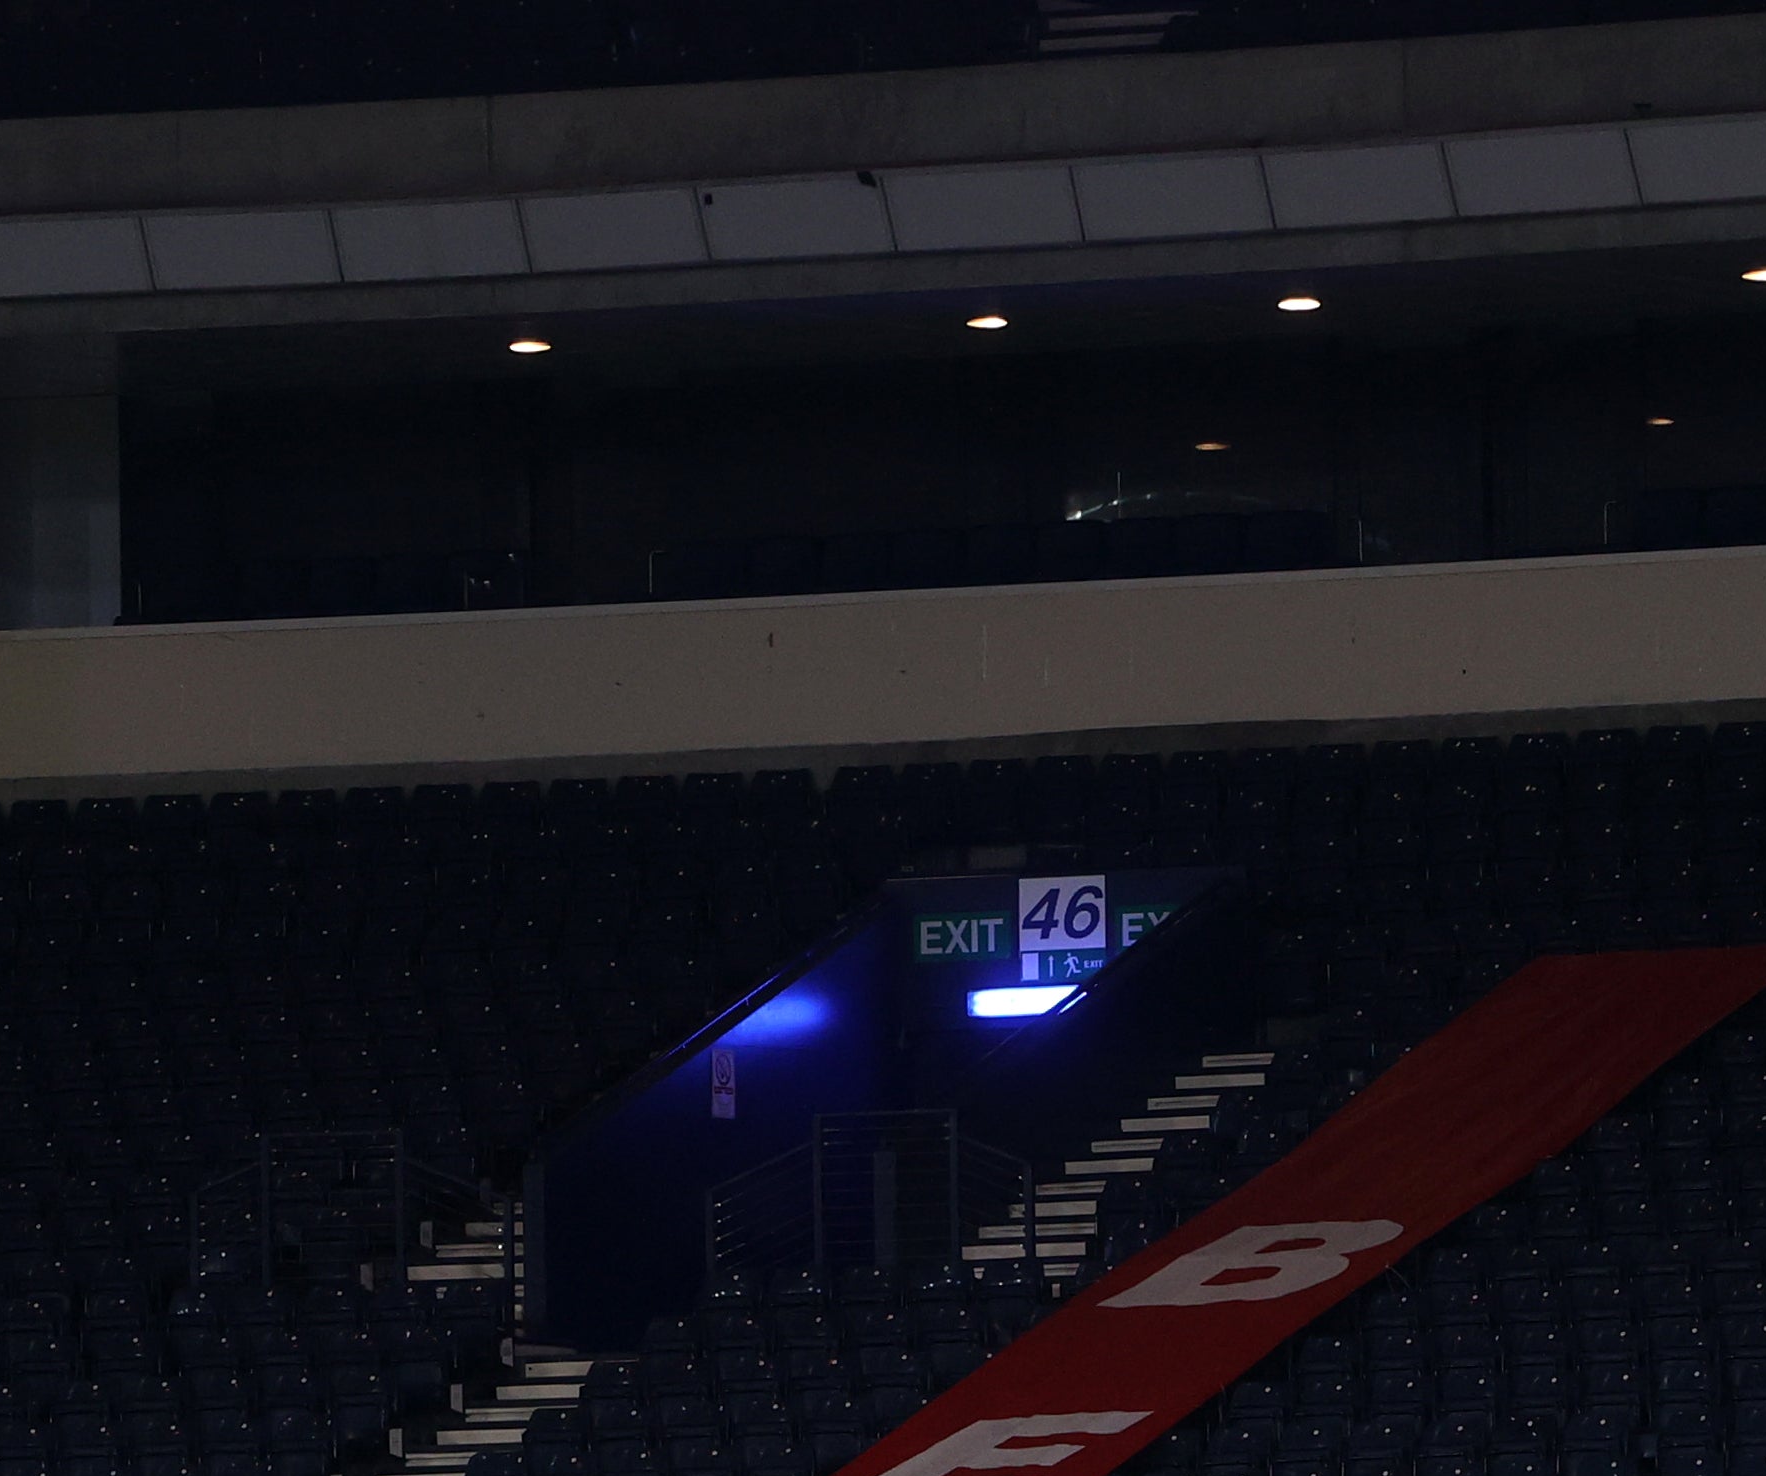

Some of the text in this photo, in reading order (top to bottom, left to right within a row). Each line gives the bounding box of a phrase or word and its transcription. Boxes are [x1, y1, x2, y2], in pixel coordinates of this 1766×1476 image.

[1021, 884, 1104, 941] 46
[920, 917, 1005, 956] EXIT
[1083, 958, 1104, 969] EXIT
